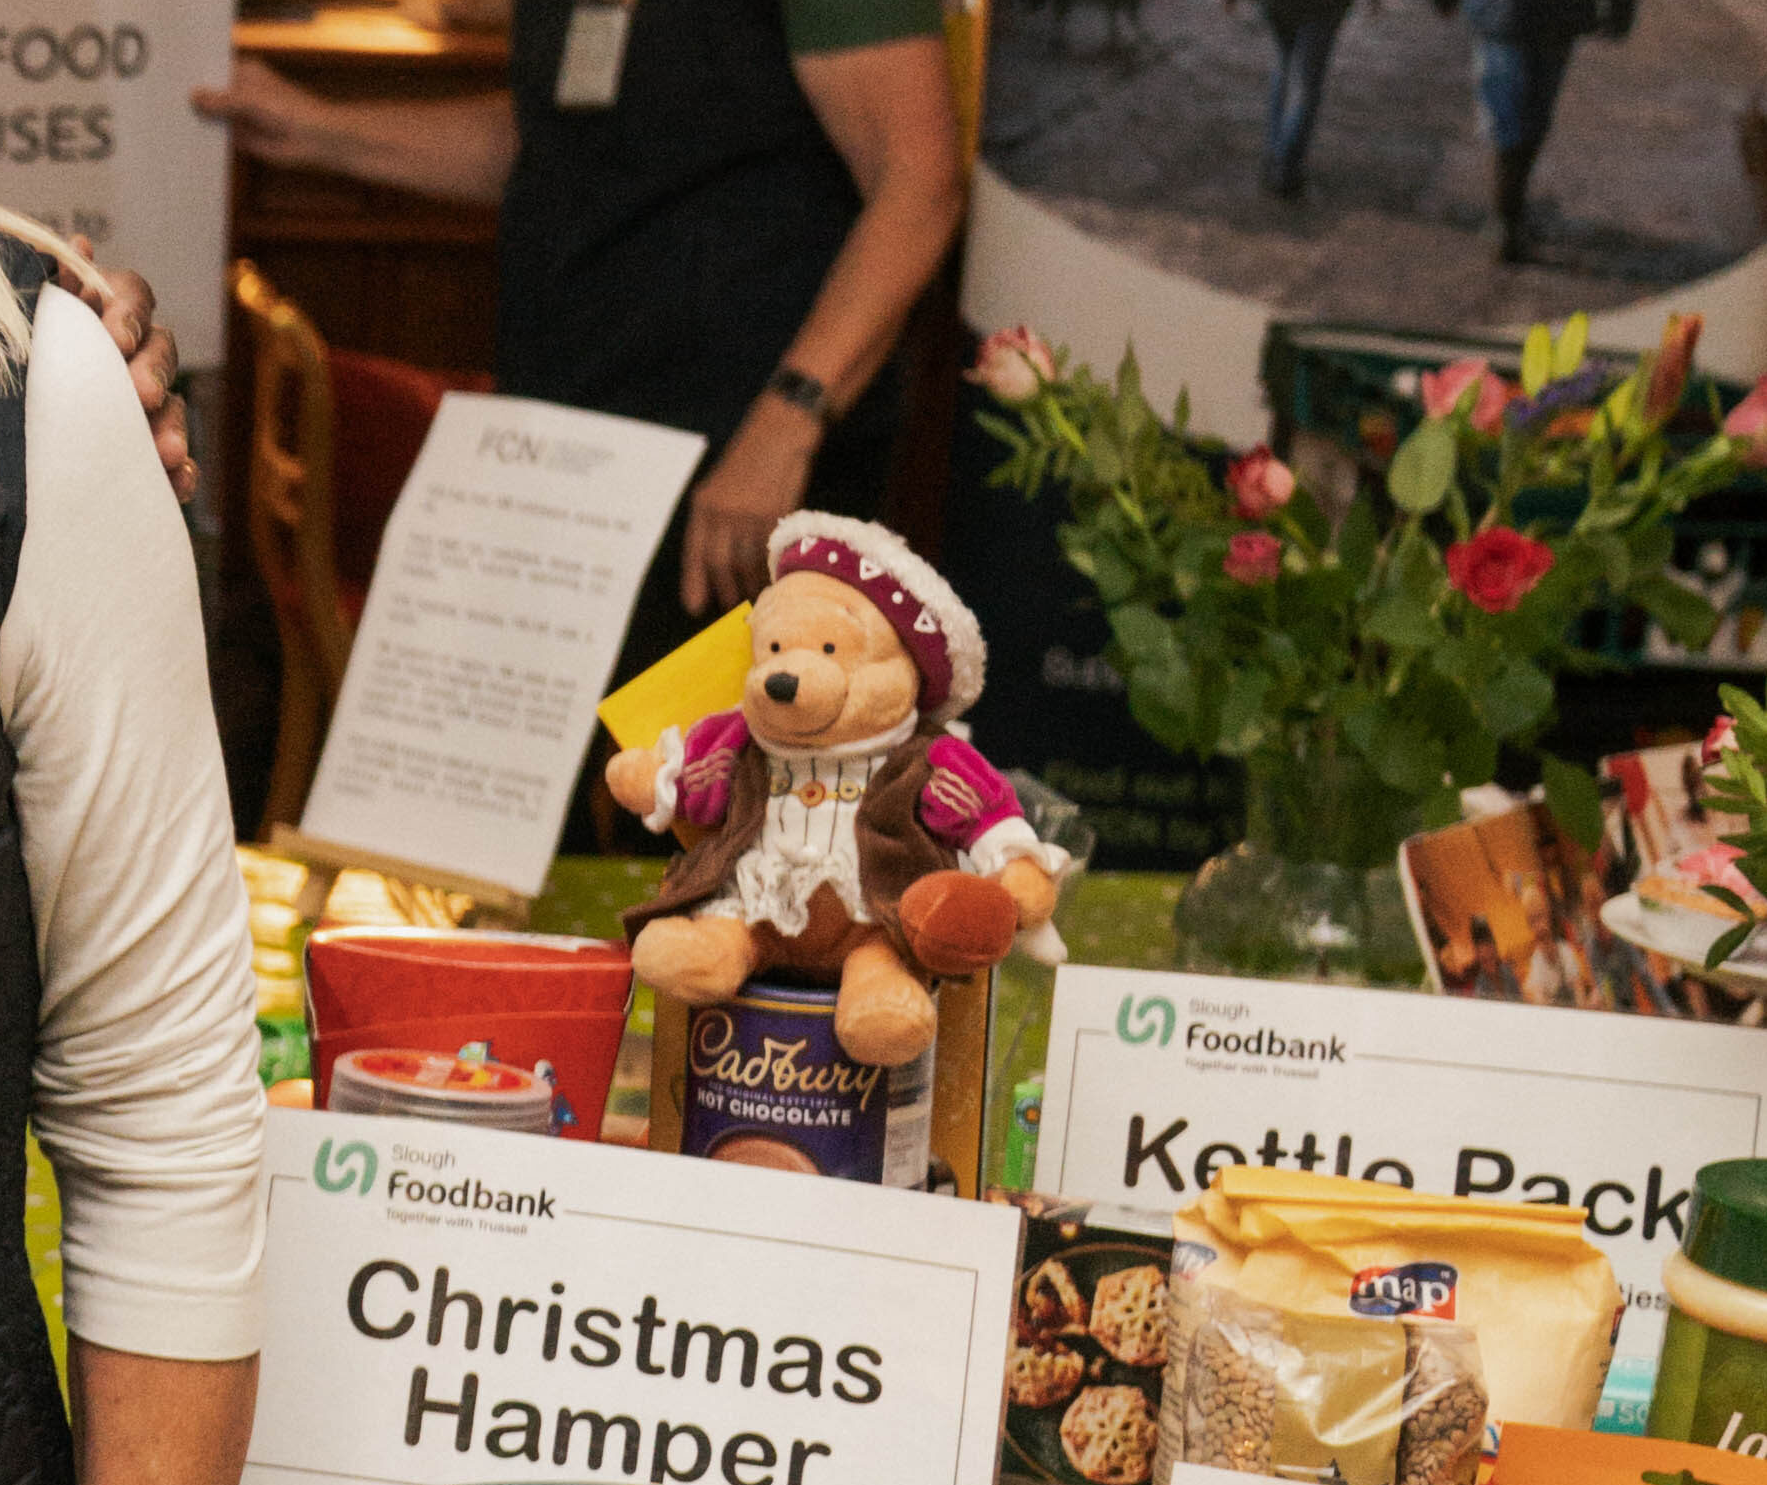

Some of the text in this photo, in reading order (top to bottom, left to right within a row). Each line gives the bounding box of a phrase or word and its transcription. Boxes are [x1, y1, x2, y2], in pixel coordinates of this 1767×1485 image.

[1189, 997, 1251, 1020] Slough
[690, 1009, 882, 1112] Cadbury
[1186, 1021, 1347, 1064] Foodbank
[697, 1087, 852, 1127] HOT CHOCOLATE
[391, 1143, 456, 1169] Slough
[387, 1169, 557, 1220] Foodbank
[346, 1259, 883, 1405] Christmas
